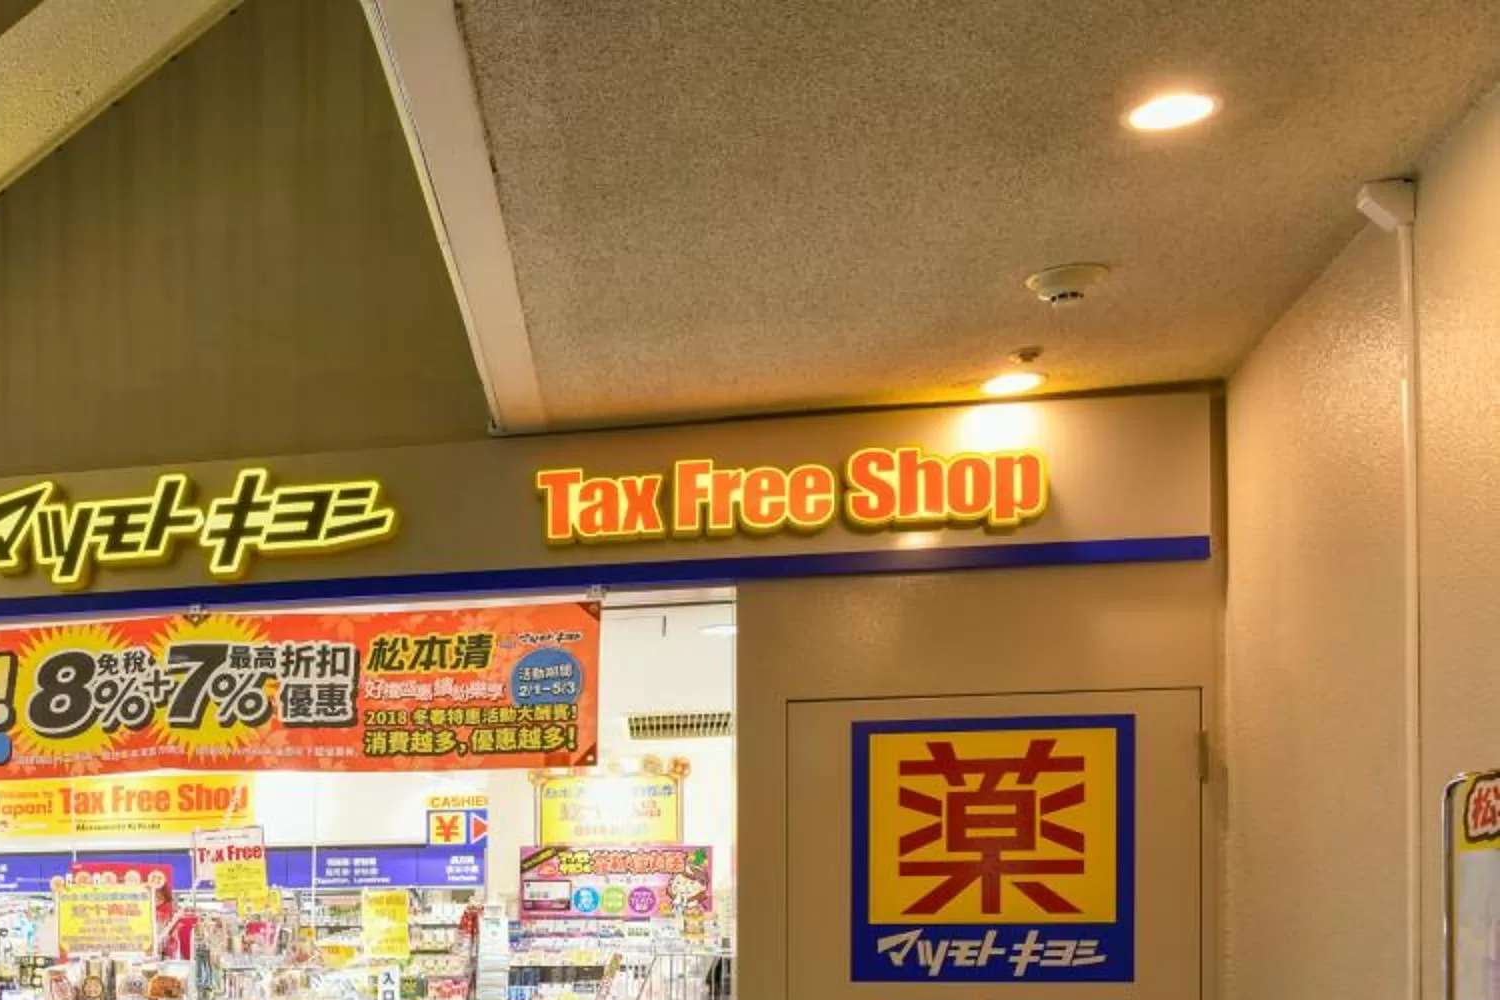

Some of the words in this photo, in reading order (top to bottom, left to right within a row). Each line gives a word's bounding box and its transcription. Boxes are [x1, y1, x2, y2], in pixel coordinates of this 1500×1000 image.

[538, 468, 663, 540] Tax
[673, 460, 835, 533] Free
[847, 447, 1047, 526] Shop
[230, 645, 277, 670] 最高
[280, 644, 355, 679] 折扣
[367, 632, 494, 673] 松本清
[279, 681, 355, 723] 優惠
[366, 710, 409, 725] 2018
[59, 787, 104, 814] Tax
[111, 785, 170, 812] Free
[178, 783, 249, 813] Shop
[898, 739, 1085, 915] 薬
[227, 844, 262, 861] Free
[877, 928, 1106, 977] マツモトキヨシ
